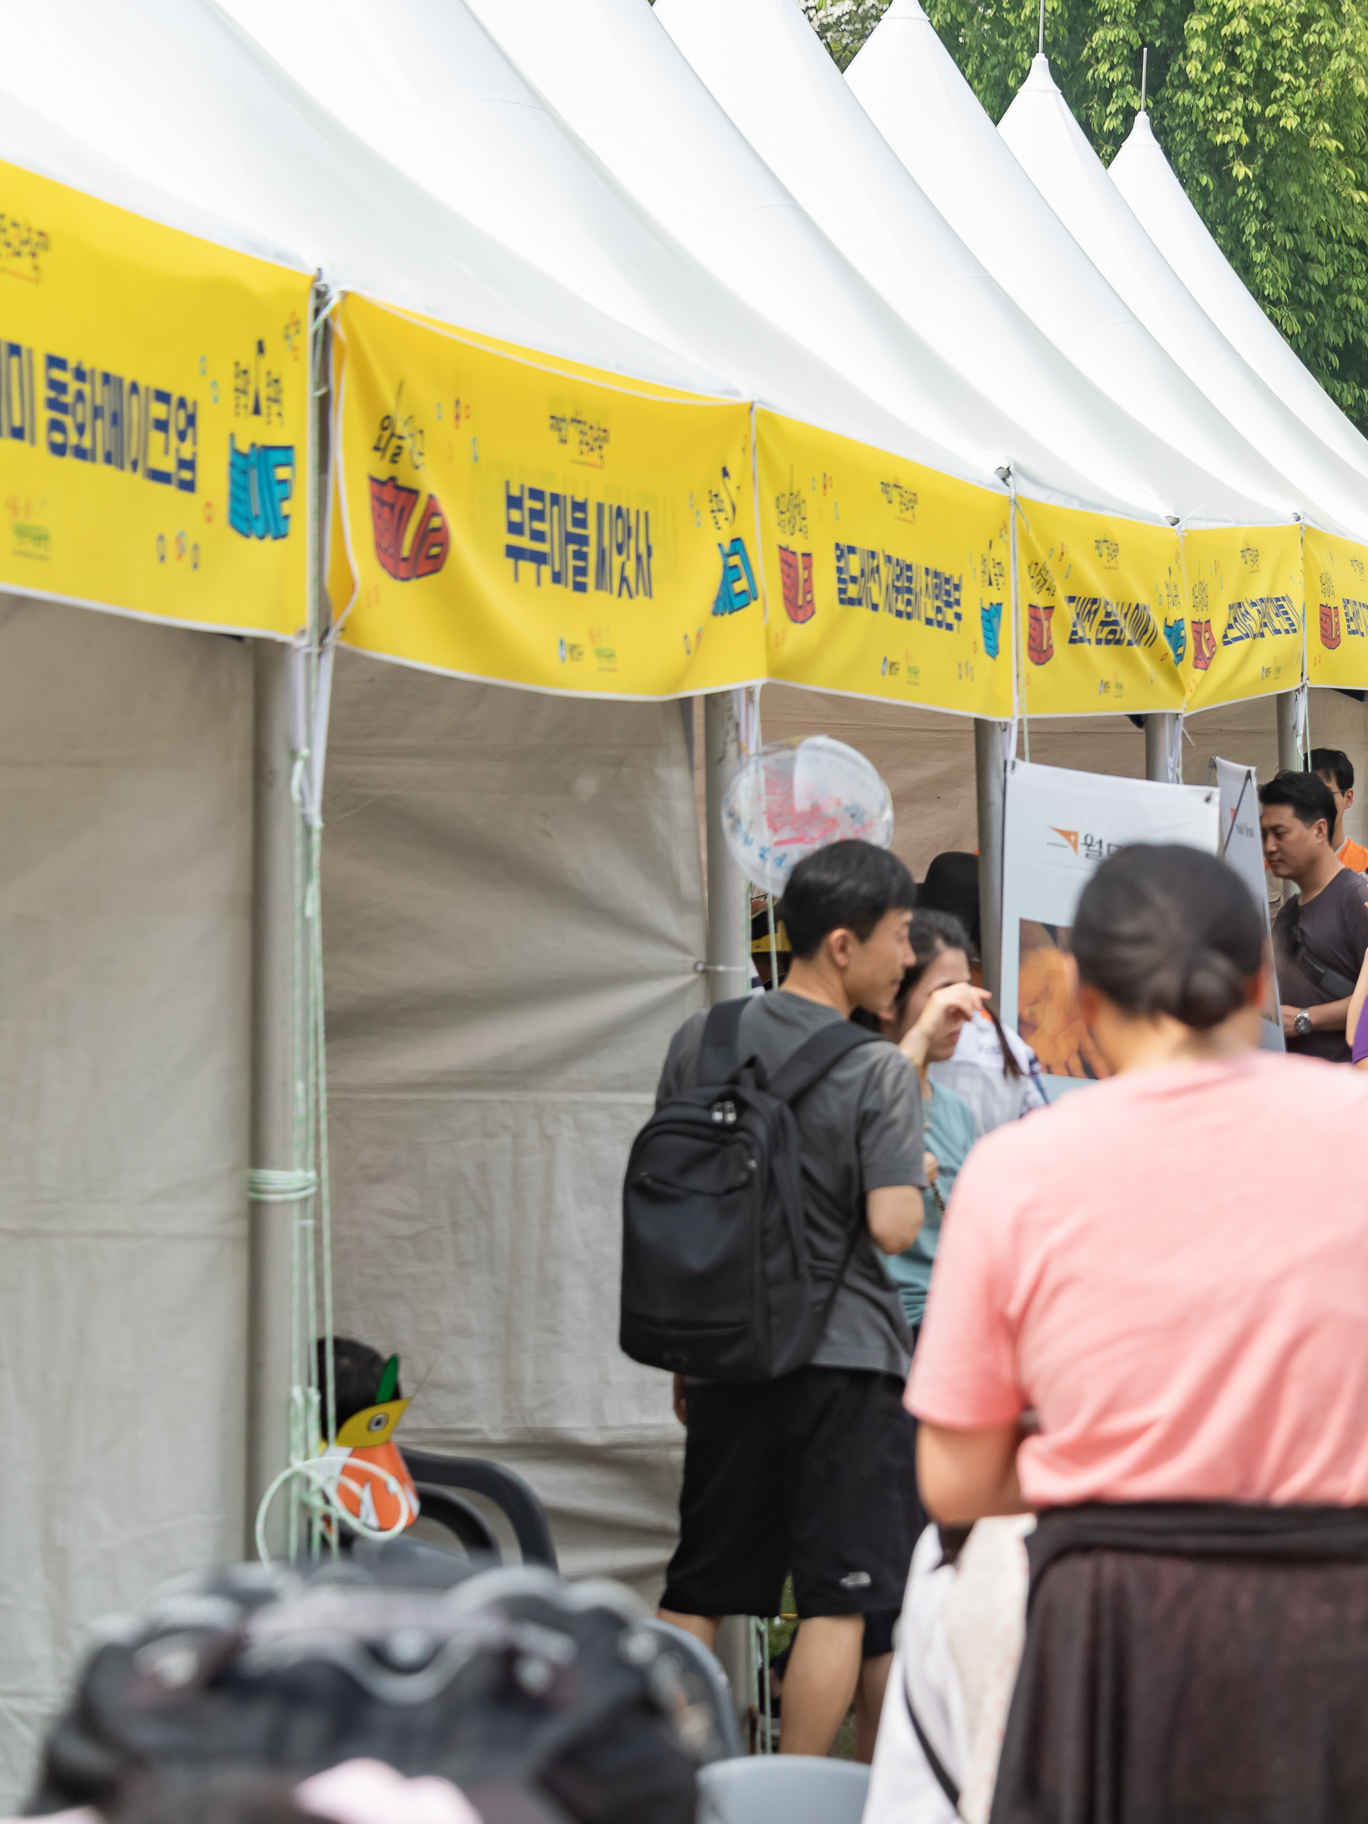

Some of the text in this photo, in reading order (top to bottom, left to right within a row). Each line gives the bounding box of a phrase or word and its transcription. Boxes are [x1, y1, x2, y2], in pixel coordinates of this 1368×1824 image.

[44, 351, 199, 494] 동화메이크업
[503, 479, 591, 595] 부루마불
[594, 500, 654, 601] 씨앗사
